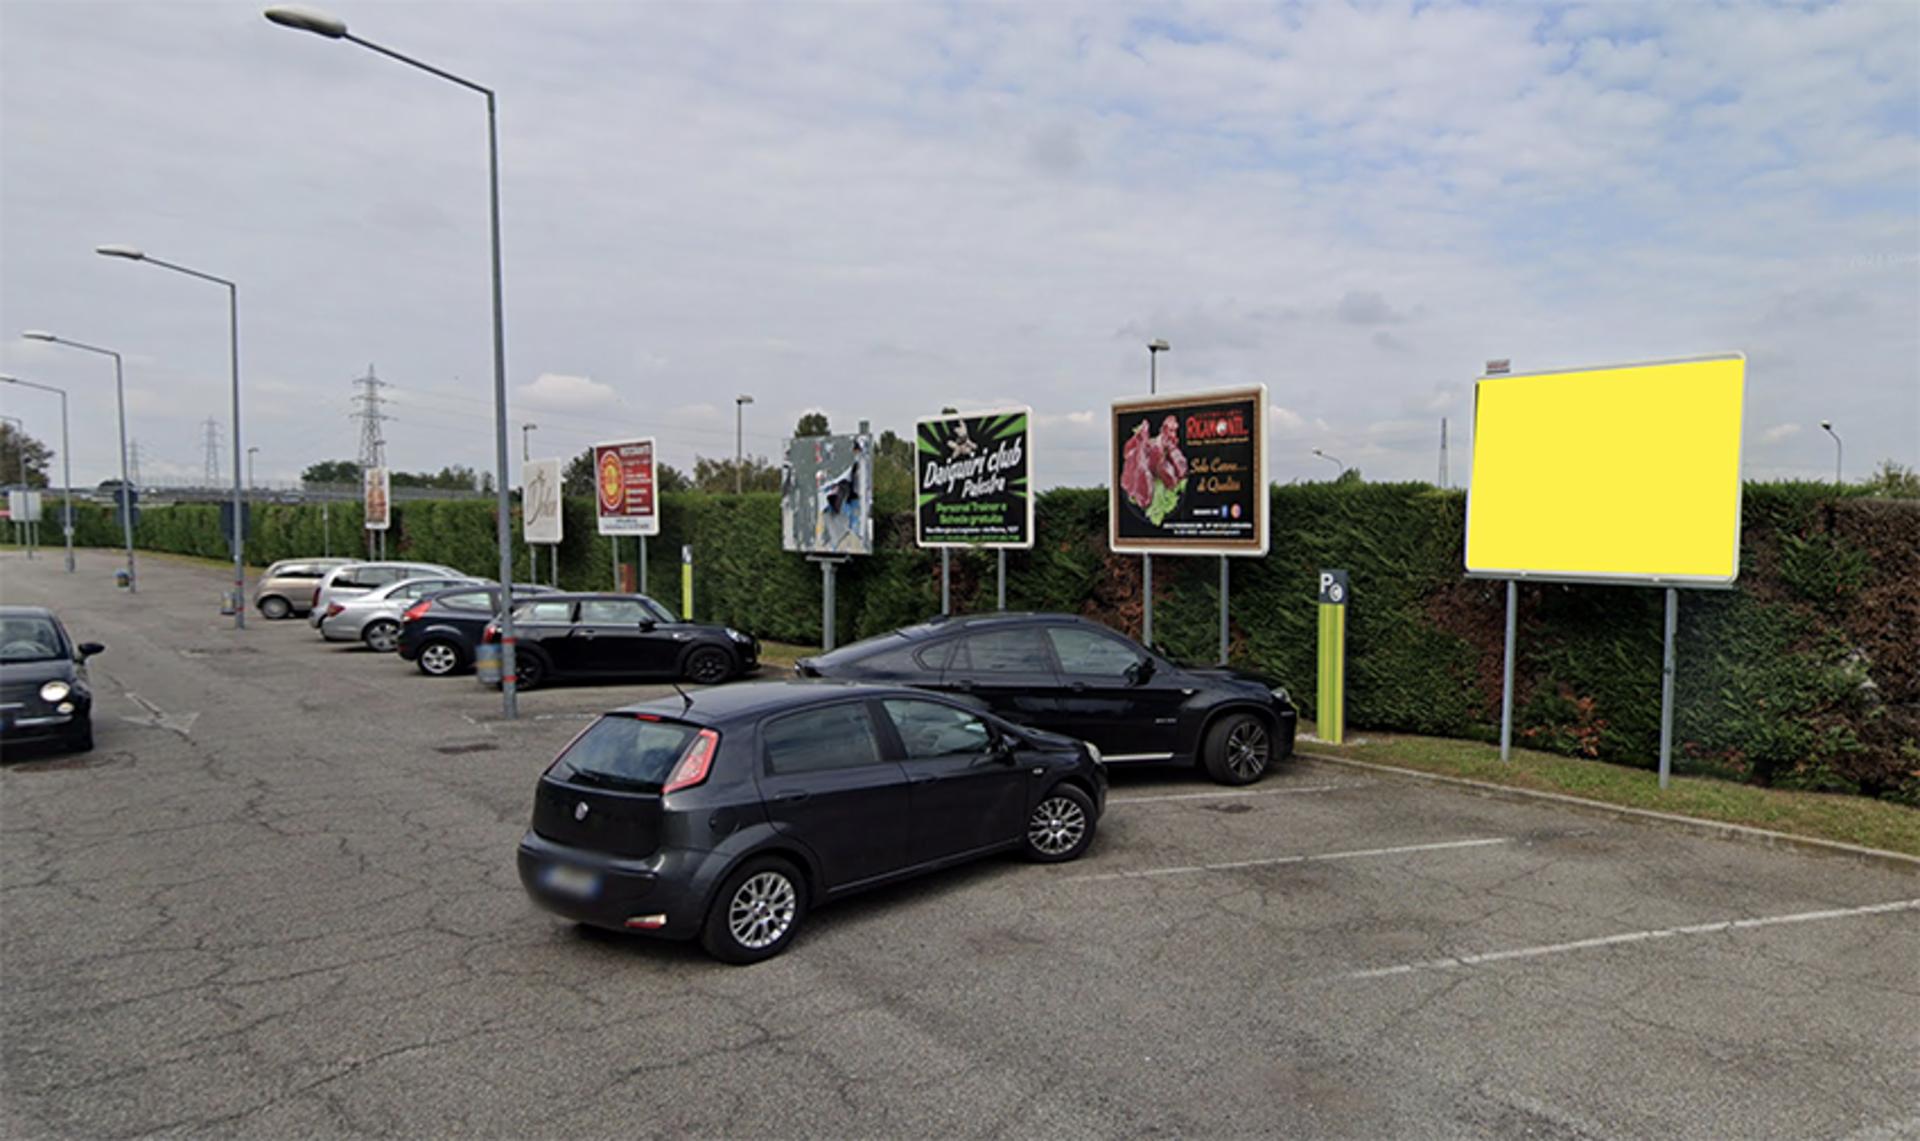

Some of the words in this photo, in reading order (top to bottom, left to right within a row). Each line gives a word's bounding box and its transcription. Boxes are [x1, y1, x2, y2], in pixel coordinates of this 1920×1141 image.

[923, 448, 987, 493] Daiquiri
[987, 436, 1022, 472] club
[962, 473, 1006, 498] Palestra
[1321, 573, 1334, 594] P
